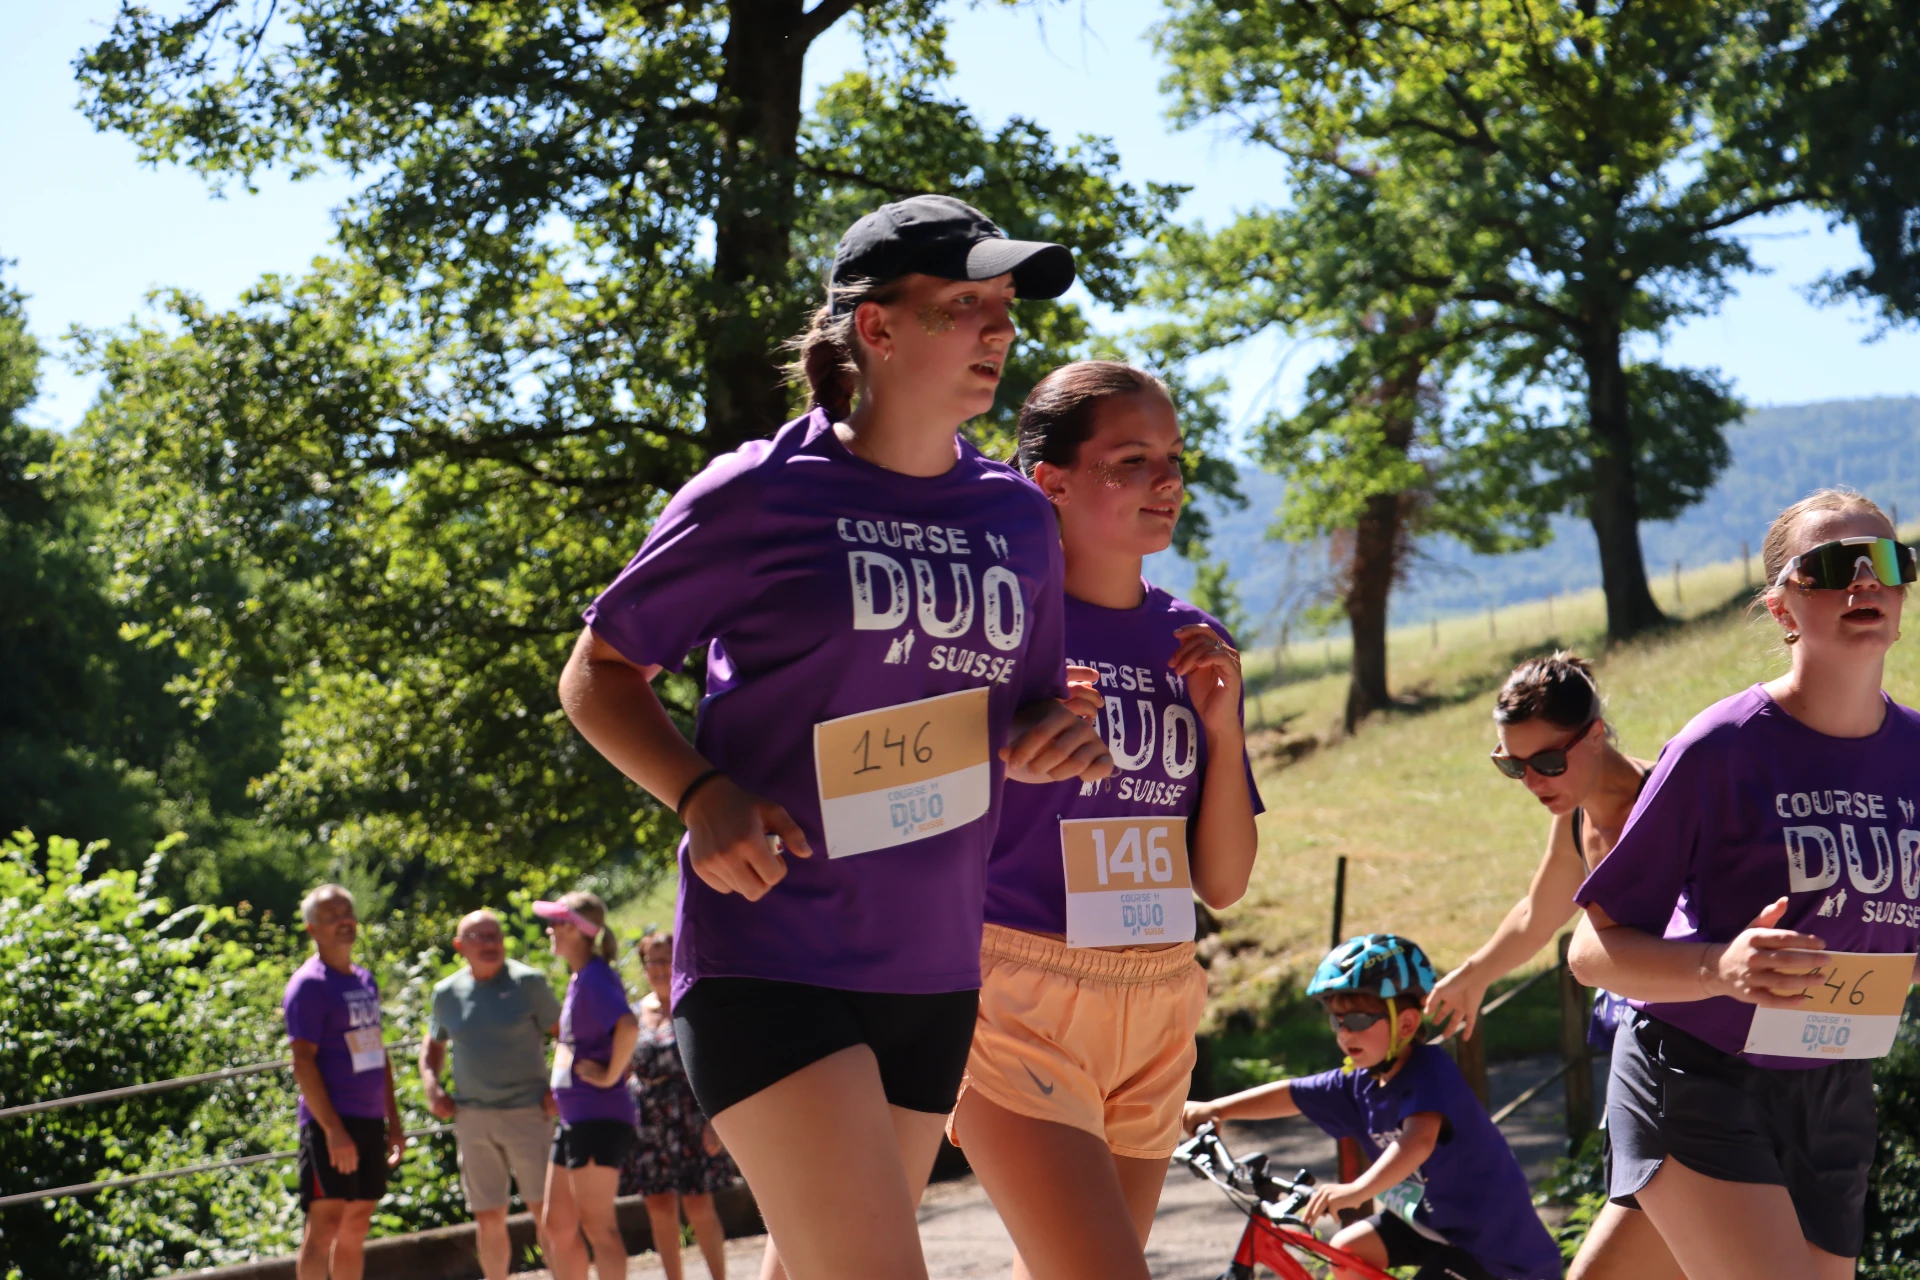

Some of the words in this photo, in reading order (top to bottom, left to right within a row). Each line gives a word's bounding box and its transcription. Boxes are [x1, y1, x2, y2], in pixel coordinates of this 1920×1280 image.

[837, 518, 971, 554] COURSE
[848, 551, 1024, 651] DUO
[928, 645, 1016, 684] SUISSE
[853, 721, 933, 775] 146
[1091, 695, 1198, 779] UO
[888, 785, 927, 801] COURSE
[1118, 777, 1187, 806] SUISSE
[1776, 790, 1888, 819] COURSE
[890, 793, 944, 828] DUO
[1092, 827, 1173, 885] 146
[1783, 823, 1920, 900] DUO
[1120, 893, 1151, 903] COURSE
[1122, 903, 1164, 928] DUO
[1801, 1024, 1851, 1047] DUO
[1806, 1014, 1840, 1024] COURSE
